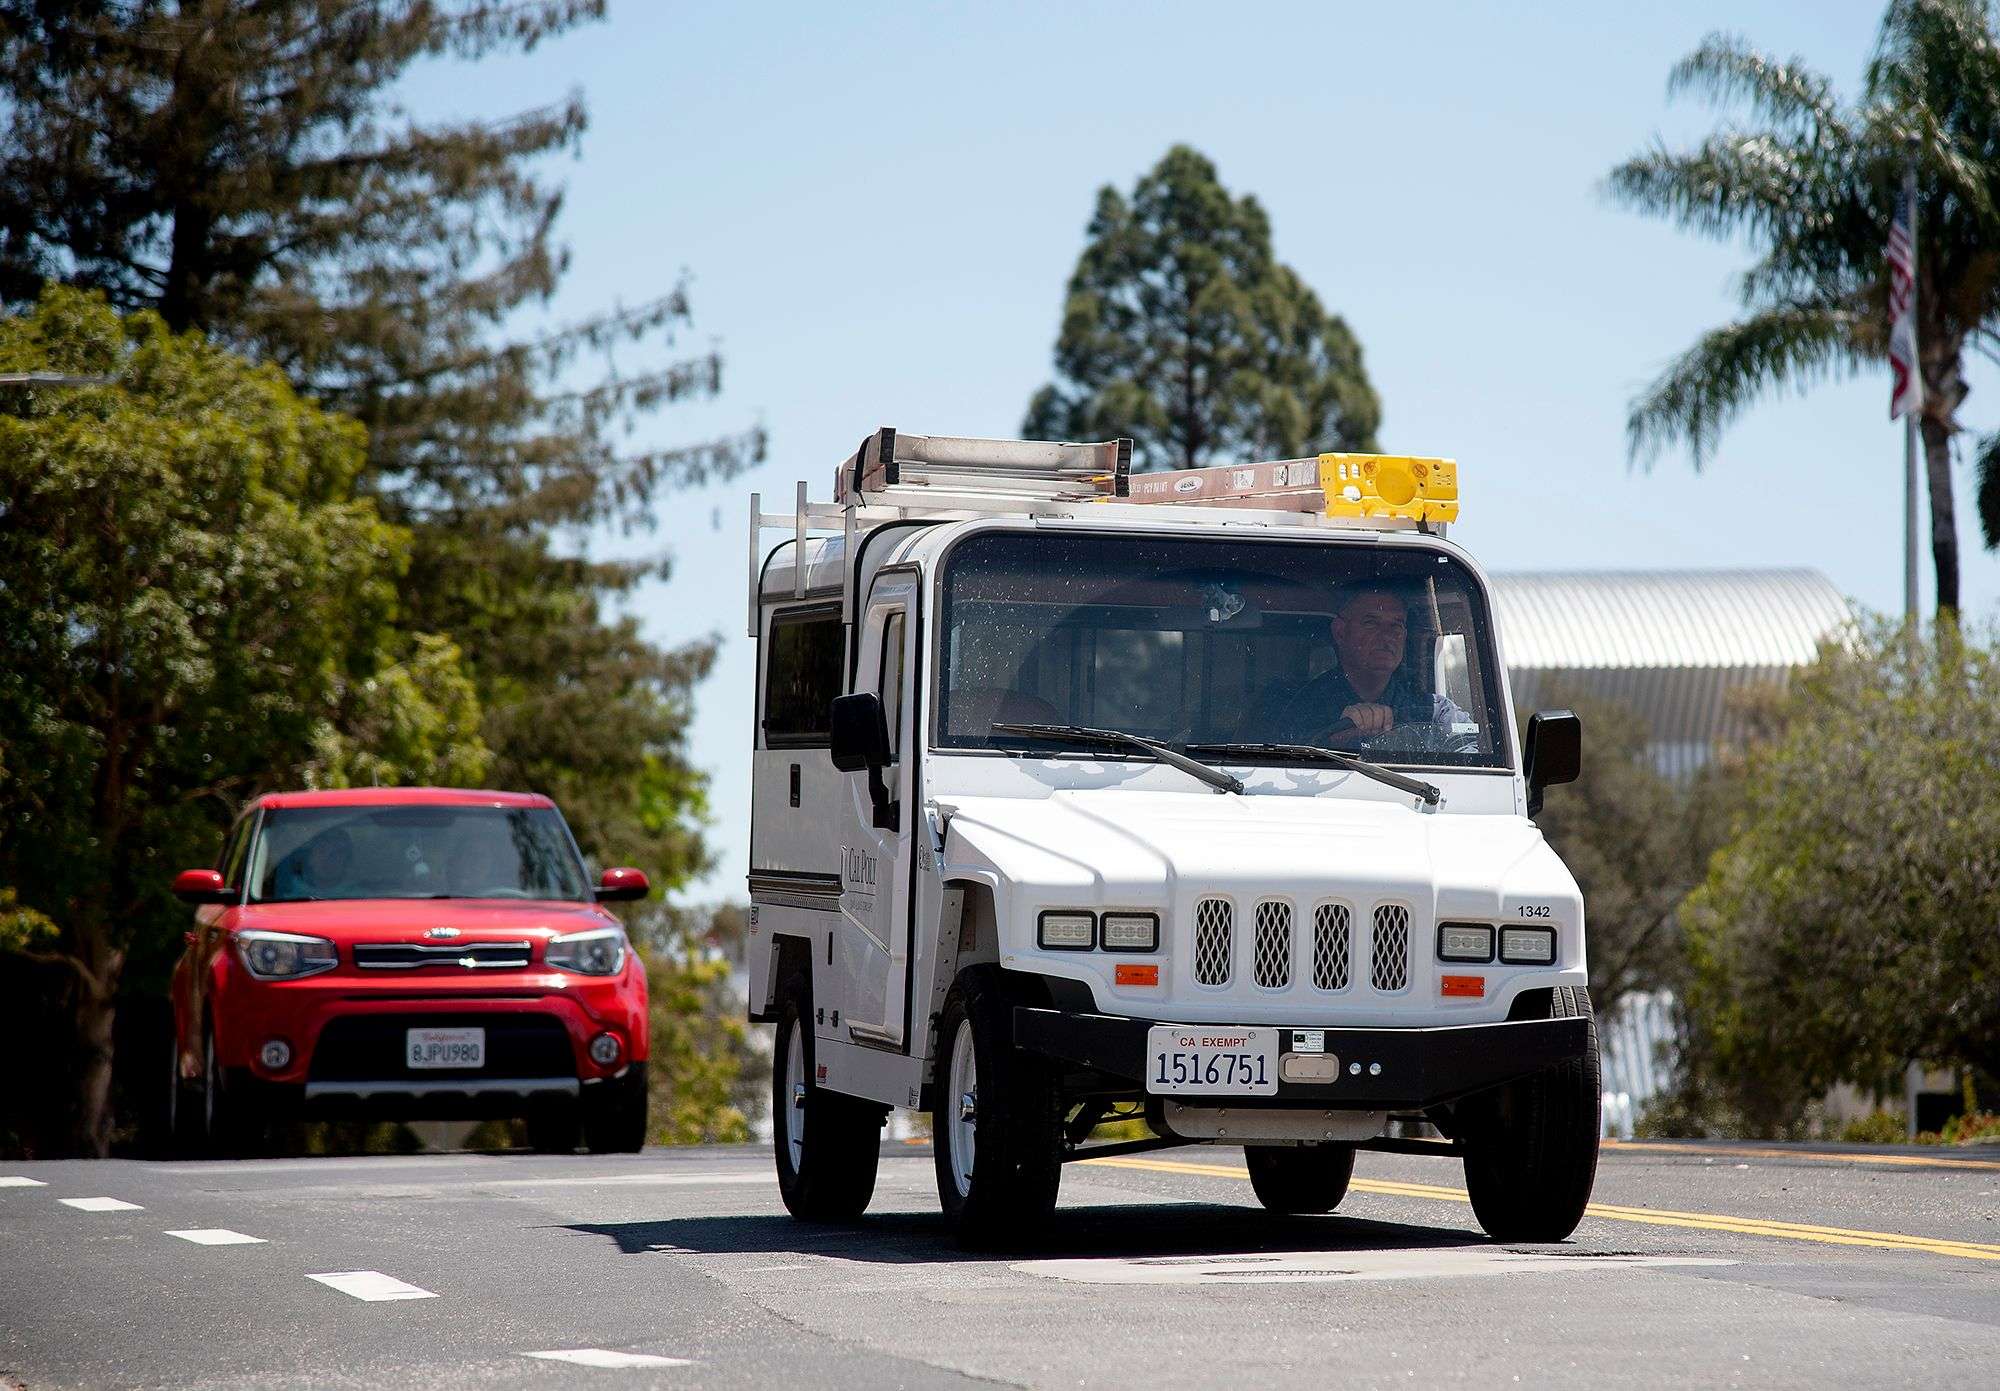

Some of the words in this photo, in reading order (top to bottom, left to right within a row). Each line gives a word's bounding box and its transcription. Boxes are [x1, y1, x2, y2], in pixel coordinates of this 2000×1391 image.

[1518, 905, 1551, 918] 1342
[1180, 1037, 1196, 1047] CA
[1202, 1037, 1247, 1047] EXEMPT
[413, 1043, 480, 1062] 8JPU980
[1156, 1053, 1269, 1085] 1516751
